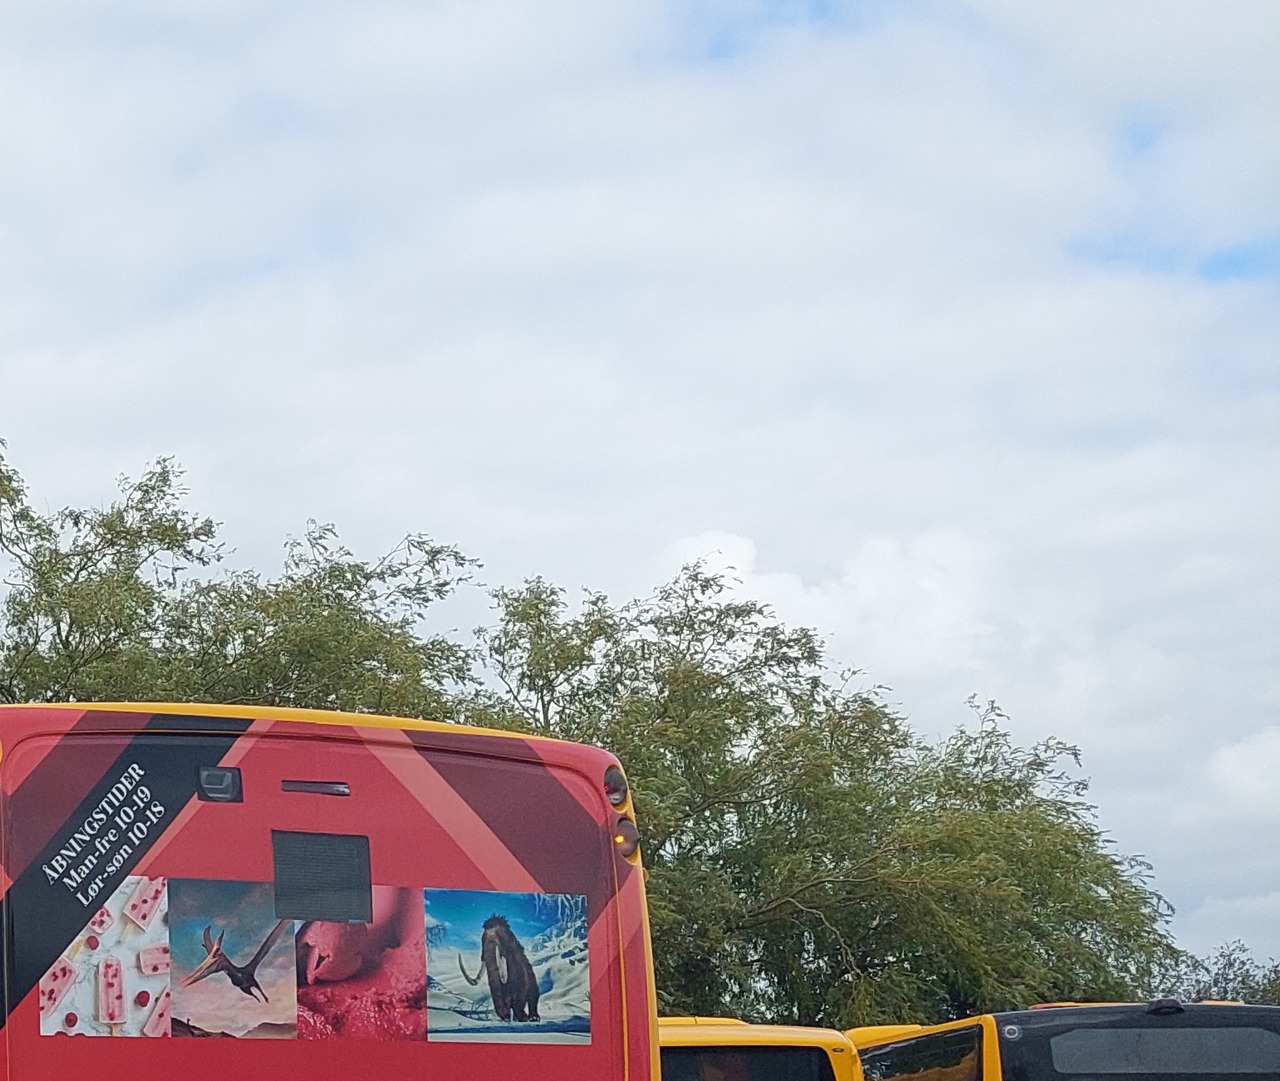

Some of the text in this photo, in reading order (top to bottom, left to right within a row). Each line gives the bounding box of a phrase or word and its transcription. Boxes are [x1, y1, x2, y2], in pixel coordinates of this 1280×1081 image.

[42, 763, 145, 885] ÅBNINGSTIDER
[62, 785, 151, 892] Man-fre 10-19
[75, 801, 165, 907] Lør-søn 10-18
